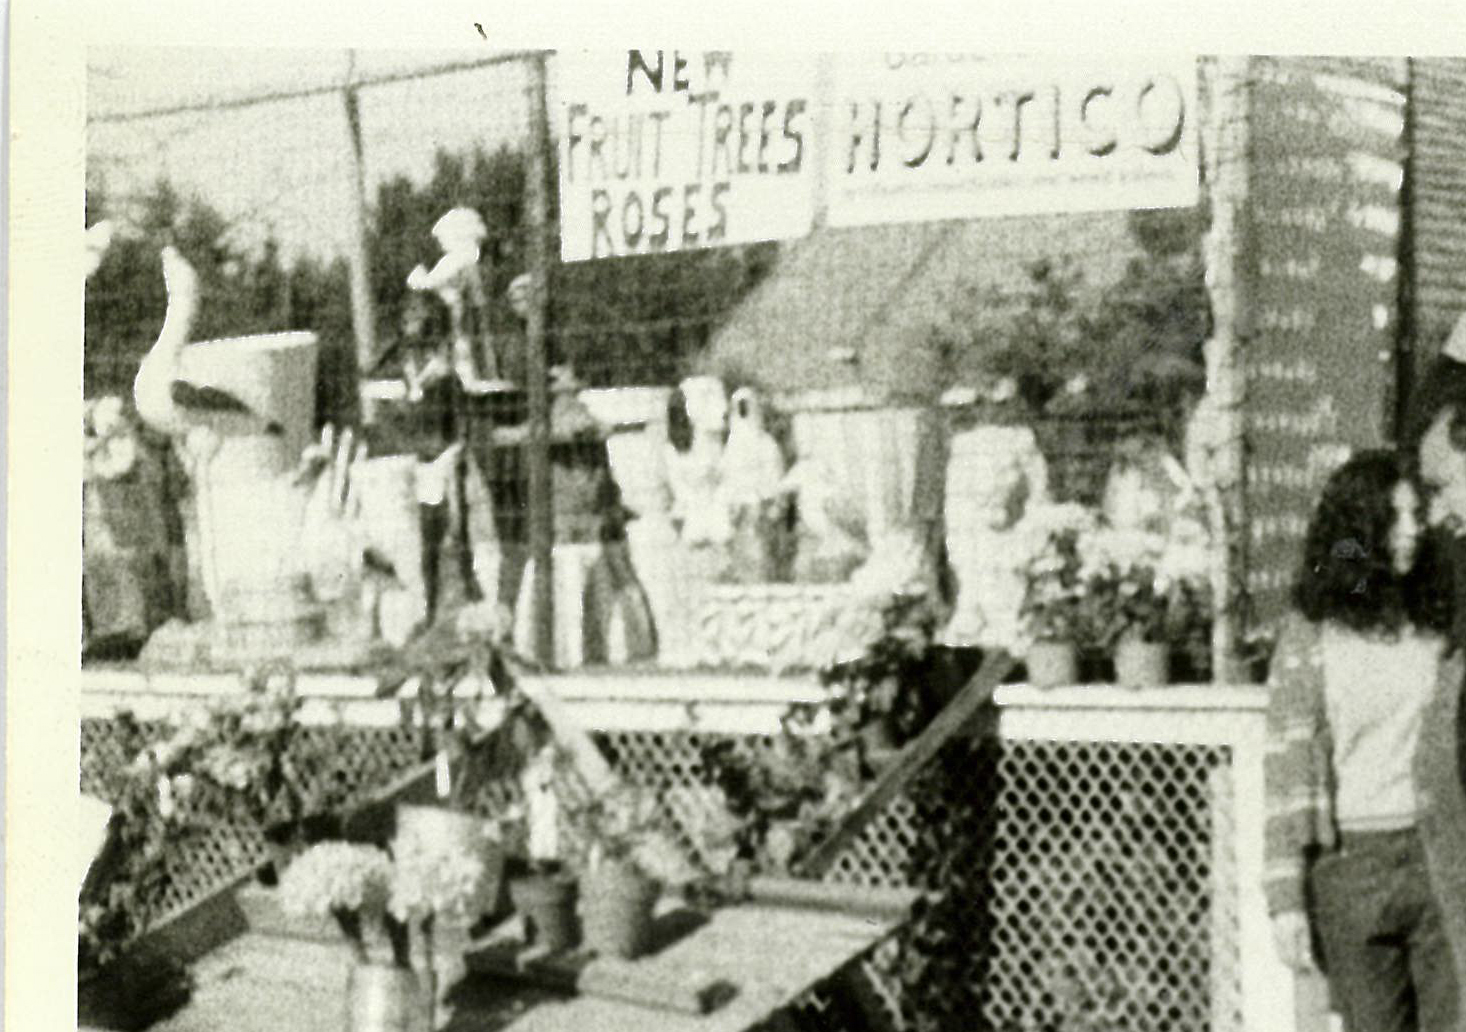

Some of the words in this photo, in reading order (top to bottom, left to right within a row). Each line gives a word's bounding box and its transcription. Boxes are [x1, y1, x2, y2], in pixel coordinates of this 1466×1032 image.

[567, 103, 672, 182] FRUIT
[686, 91, 808, 179] TREES
[844, 73, 1186, 174] HORTICO
[590, 181, 731, 257] ROSES
